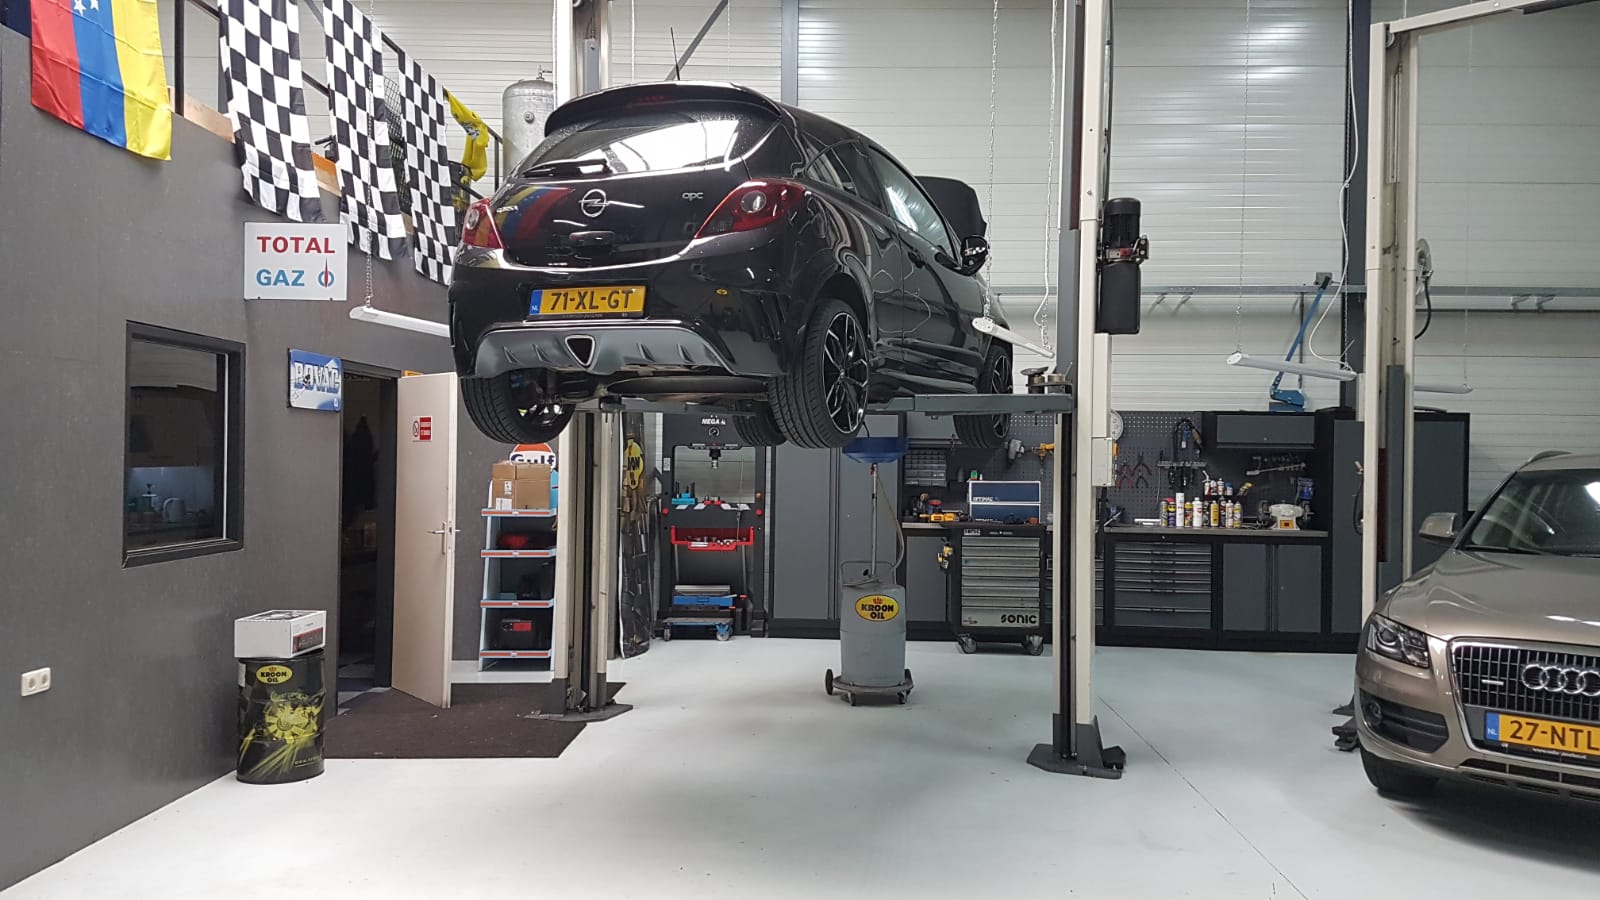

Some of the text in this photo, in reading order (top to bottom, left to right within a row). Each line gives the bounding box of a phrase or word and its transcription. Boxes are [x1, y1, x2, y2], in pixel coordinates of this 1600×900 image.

[257, 236, 335, 254] TOTAL
[256, 269, 305, 287] GAZ
[550, 289, 635, 311] 71-XL-GT
[861, 603, 894, 612] KROON
[870, 611, 885, 619] OIL
[1487, 720, 1600, 751] NL 27-NTL
